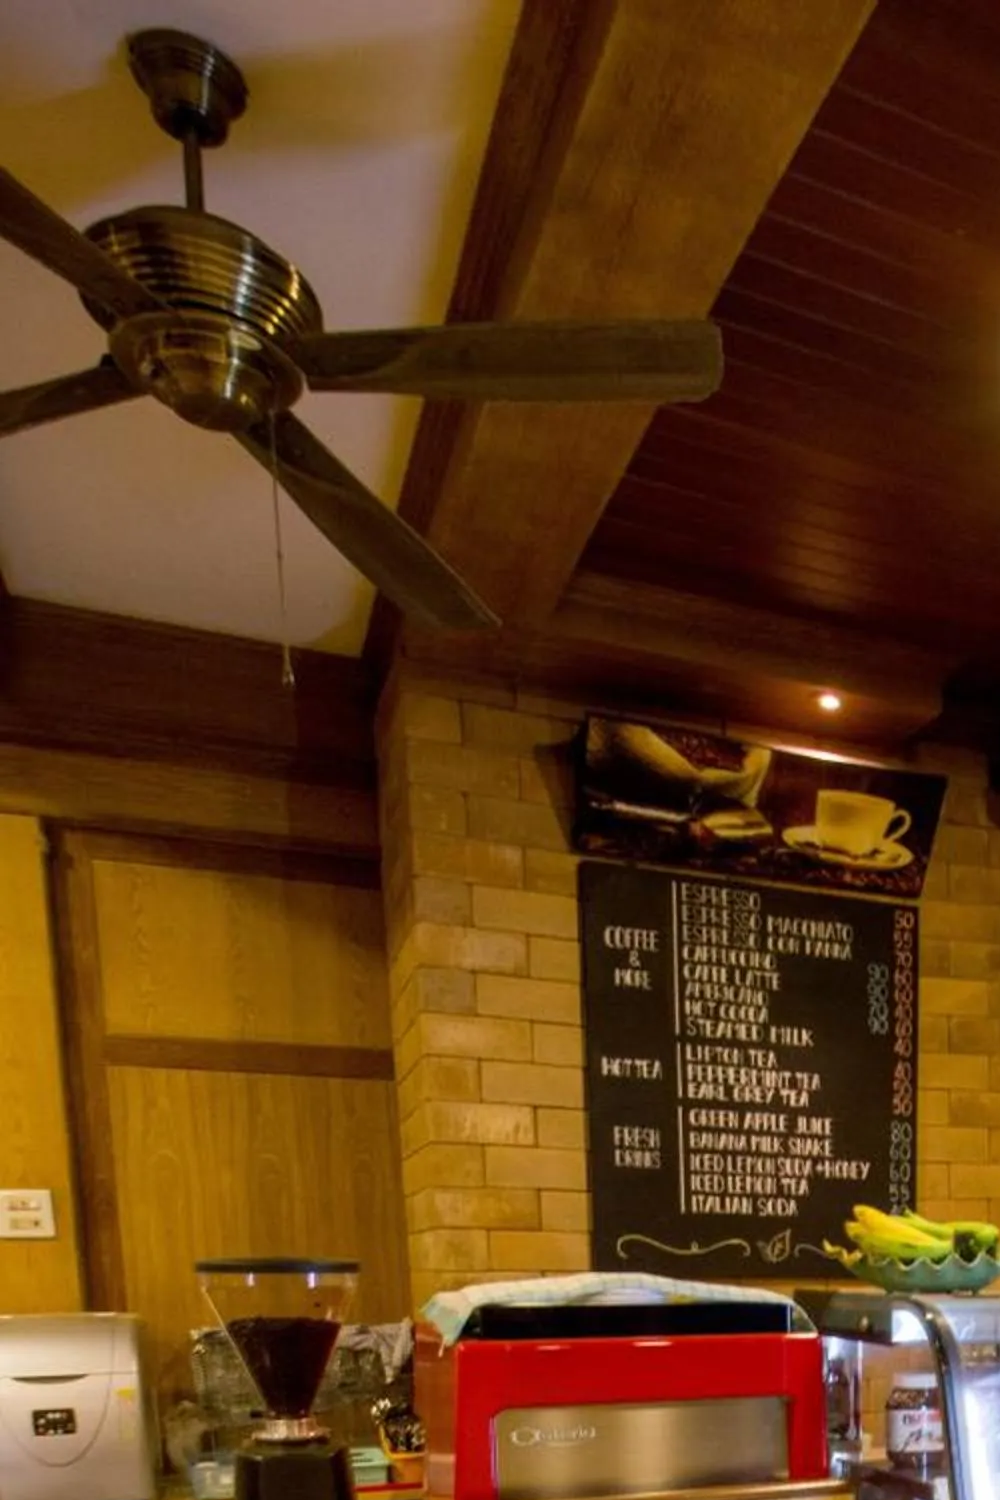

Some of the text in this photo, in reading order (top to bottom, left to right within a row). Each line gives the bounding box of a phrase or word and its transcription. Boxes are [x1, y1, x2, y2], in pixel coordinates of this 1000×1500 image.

[681, 882, 761, 912] ESPRESSO
[681, 904, 762, 930] ESPRESSO
[894, 909, 914, 929] 50
[604, 925, 660, 953] COFFEE
[681, 924, 761, 948] ESPRESSO
[628, 949, 642, 968] &
[734, 968, 781, 991] LATTE
[684, 999, 717, 1018] HOT
[686, 1016, 815, 1047] STEAMED MILK
[685, 1042, 778, 1068] LIPTON TEA
[601, 1056, 662, 1080] HOT TEA
[686, 1062, 822, 1091] PEPPERMINT TEA
[687, 1082, 728, 1101] EARL
[779, 1088, 810, 1108] TEA
[688, 1107, 739, 1129] GREEN
[743, 1112, 788, 1132] APPLE
[890, 1119, 912, 1142] 80
[613, 1126, 661, 1149] FRESH
[688, 1130, 833, 1157] BANANA MILK SHAKE
[689, 1152, 724, 1173] ICED
[726, 1154, 775, 1175] LEMON
[777, 1156, 814, 1178] SODA
[889, 1161, 911, 1183] 60
[690, 1173, 810, 1196] ICED LEMON TEA
[888, 1182, 910, 1203] 55
[690, 1194, 799, 1217] ITALIAN SODA
